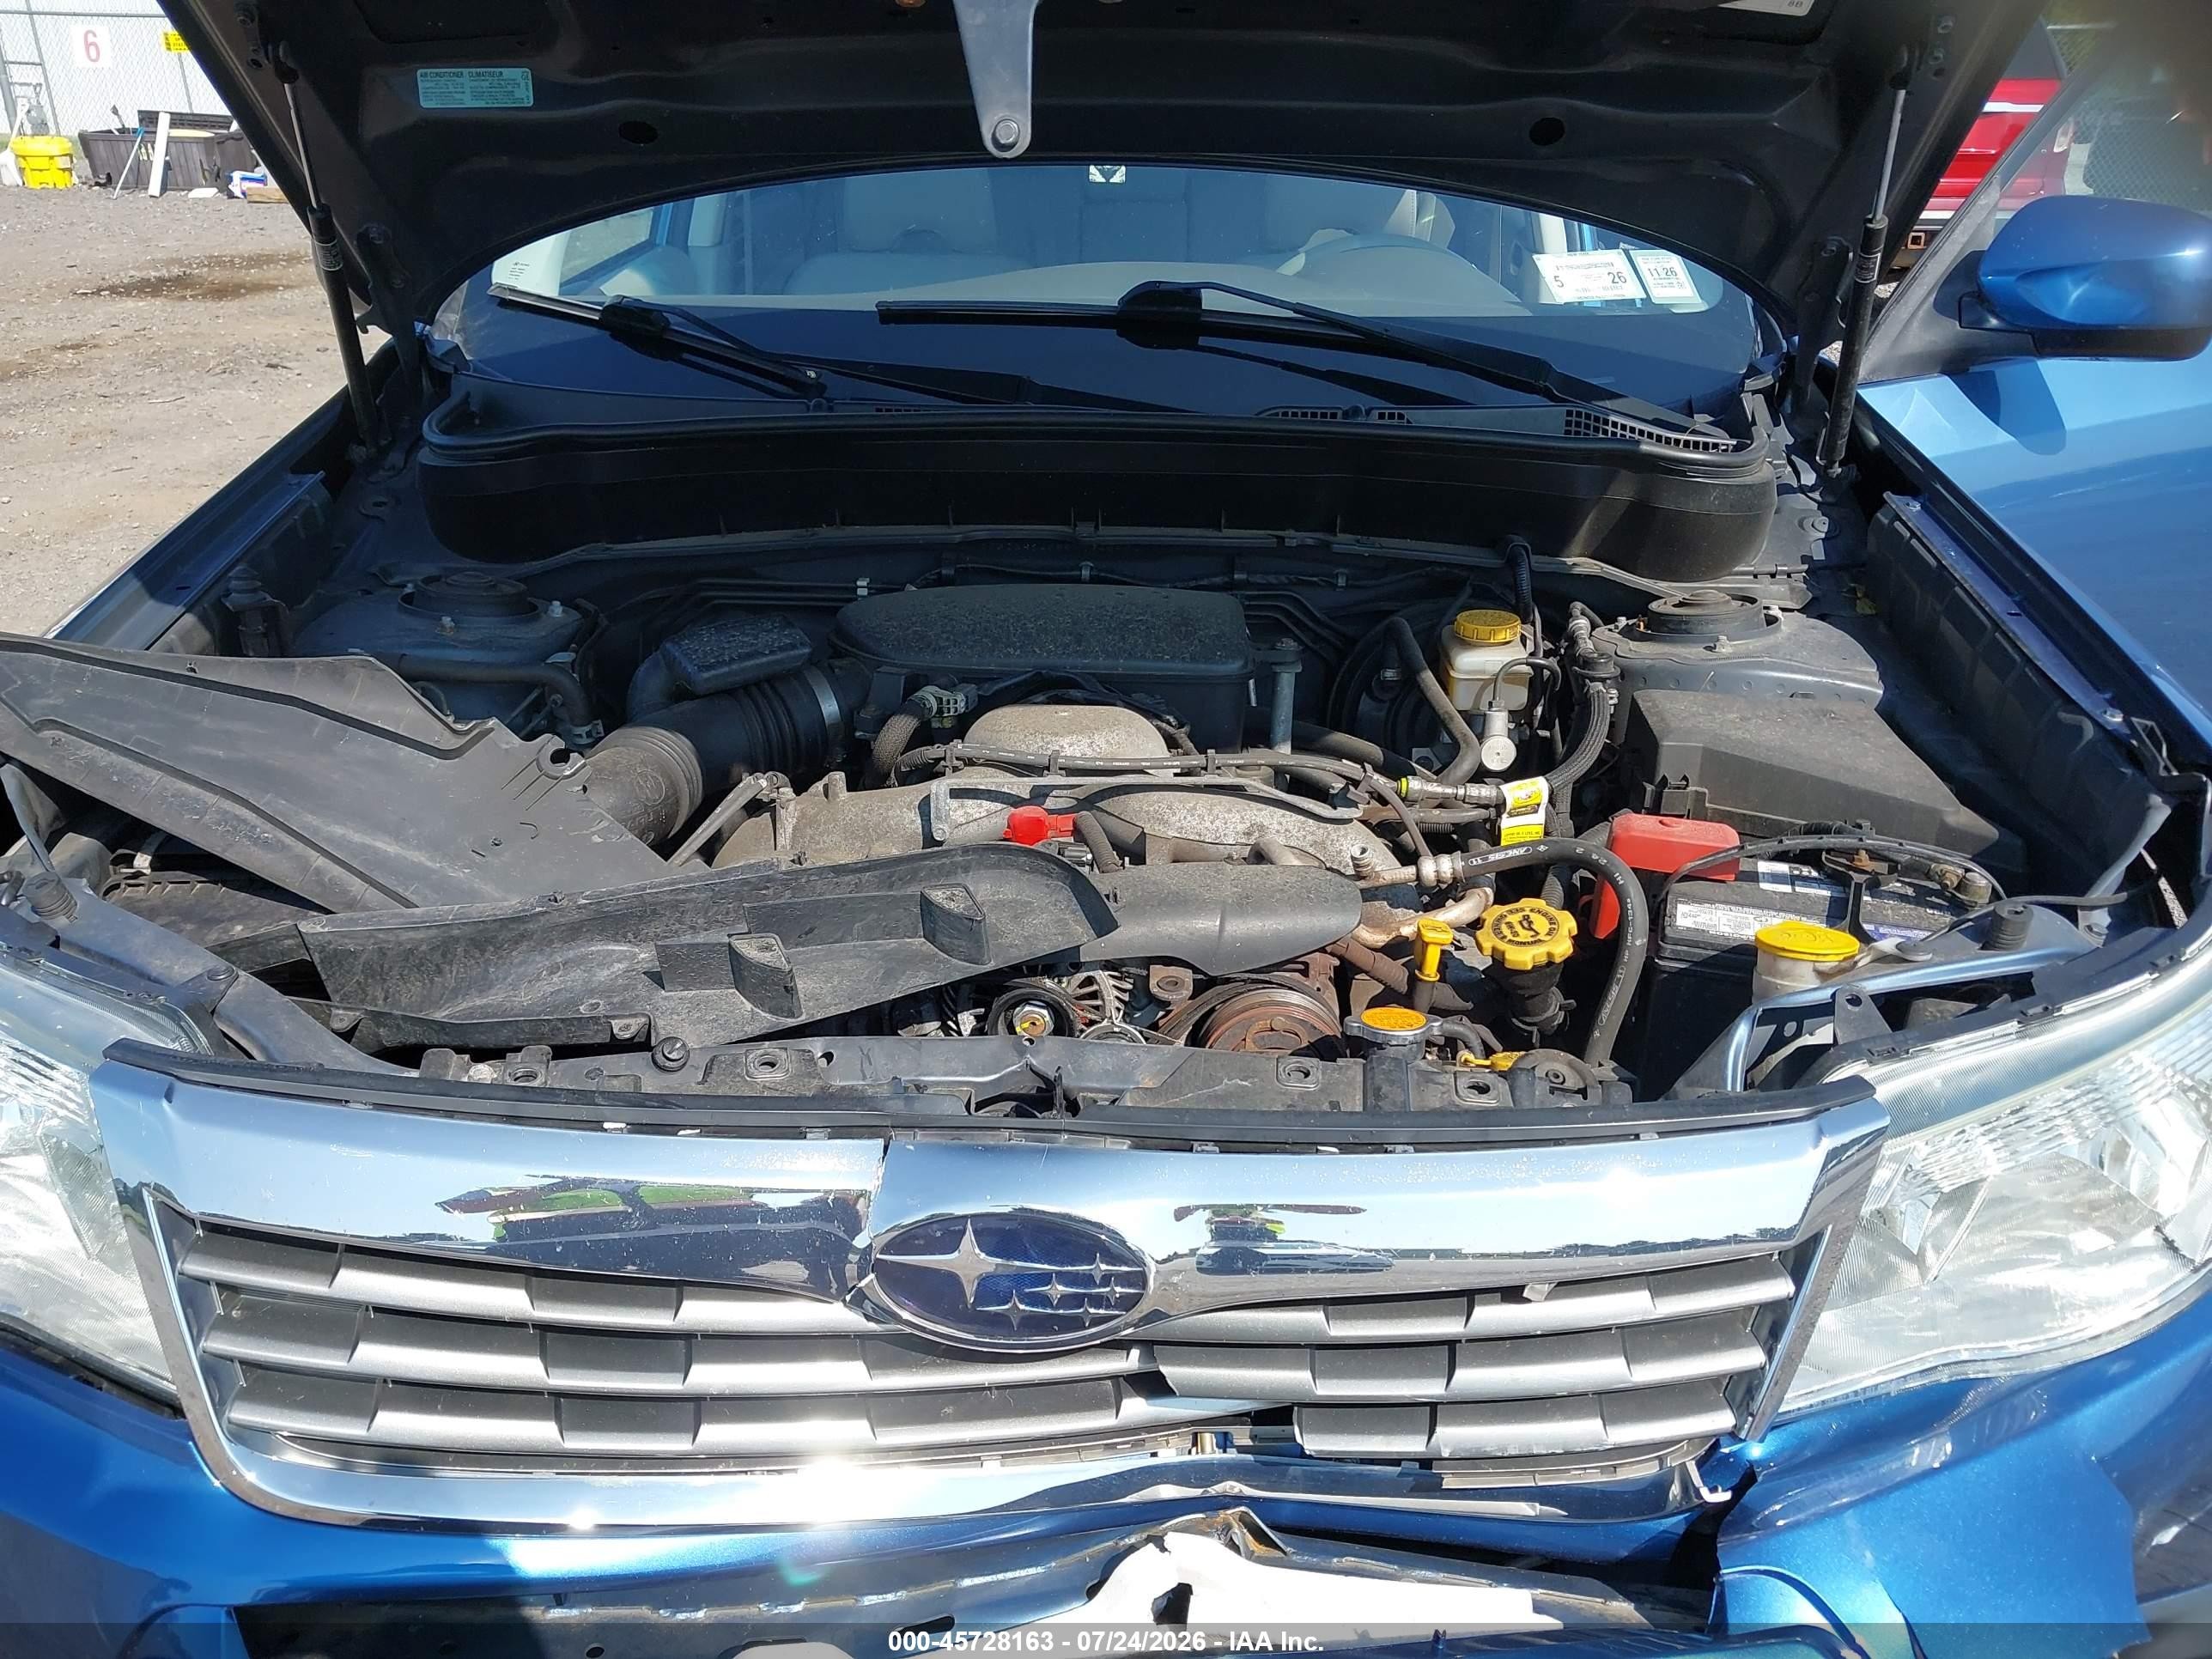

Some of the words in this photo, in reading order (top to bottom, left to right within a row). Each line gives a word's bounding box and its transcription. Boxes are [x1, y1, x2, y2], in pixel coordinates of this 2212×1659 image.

[83, 29, 100, 63] 6
[1607, 271, 1627, 284] 26
[1662, 266, 1678, 276] 26
[1553, 275, 1565, 288] 5
[1528, 908, 1557, 928] ENGINE
